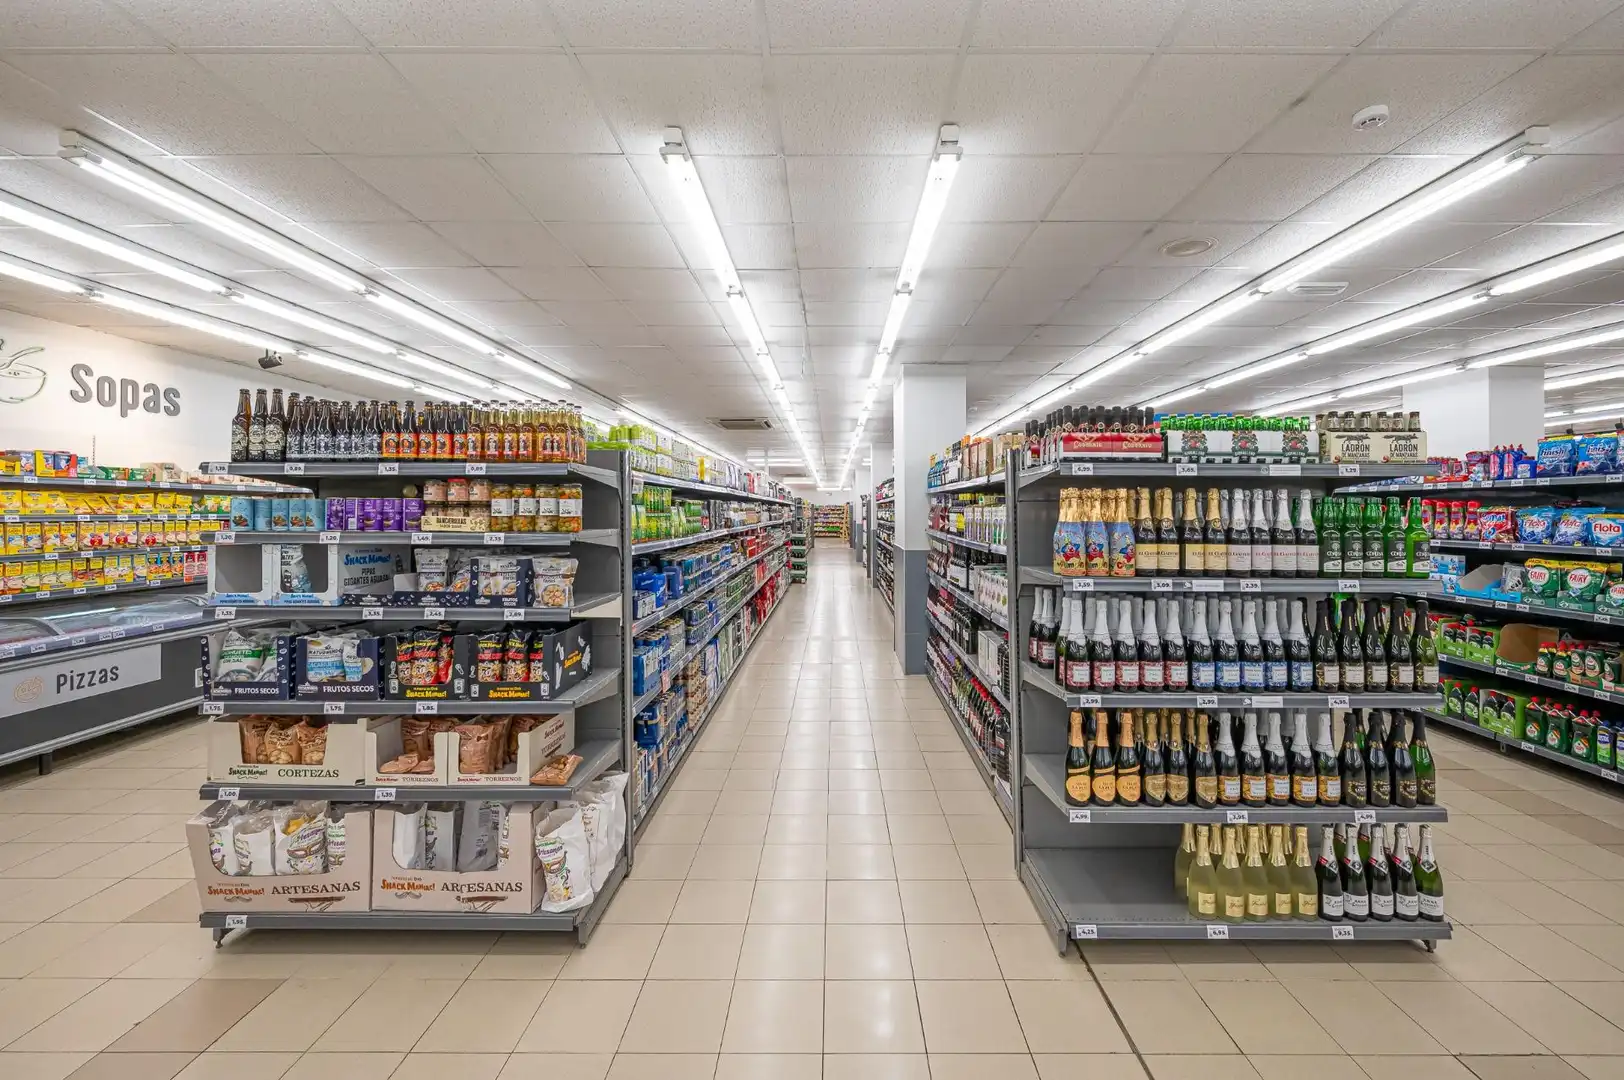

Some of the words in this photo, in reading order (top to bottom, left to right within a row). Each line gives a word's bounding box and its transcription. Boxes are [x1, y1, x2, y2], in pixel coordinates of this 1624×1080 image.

[70, 363, 181, 418] Sopas
[1594, 523, 1620, 533] Flota
[1569, 574, 1588, 583] FAIRY
[56, 666, 120, 694] Pizzas
[323, 685, 351, 693] FRUTOS
[278, 768, 339, 778] CORTEZAS
[271, 881, 361, 895] ARTESANAS
[381, 879, 407, 891] SNACK
[441, 881, 524, 893] ARTESANAS
[207, 886, 234, 896] SNACK
